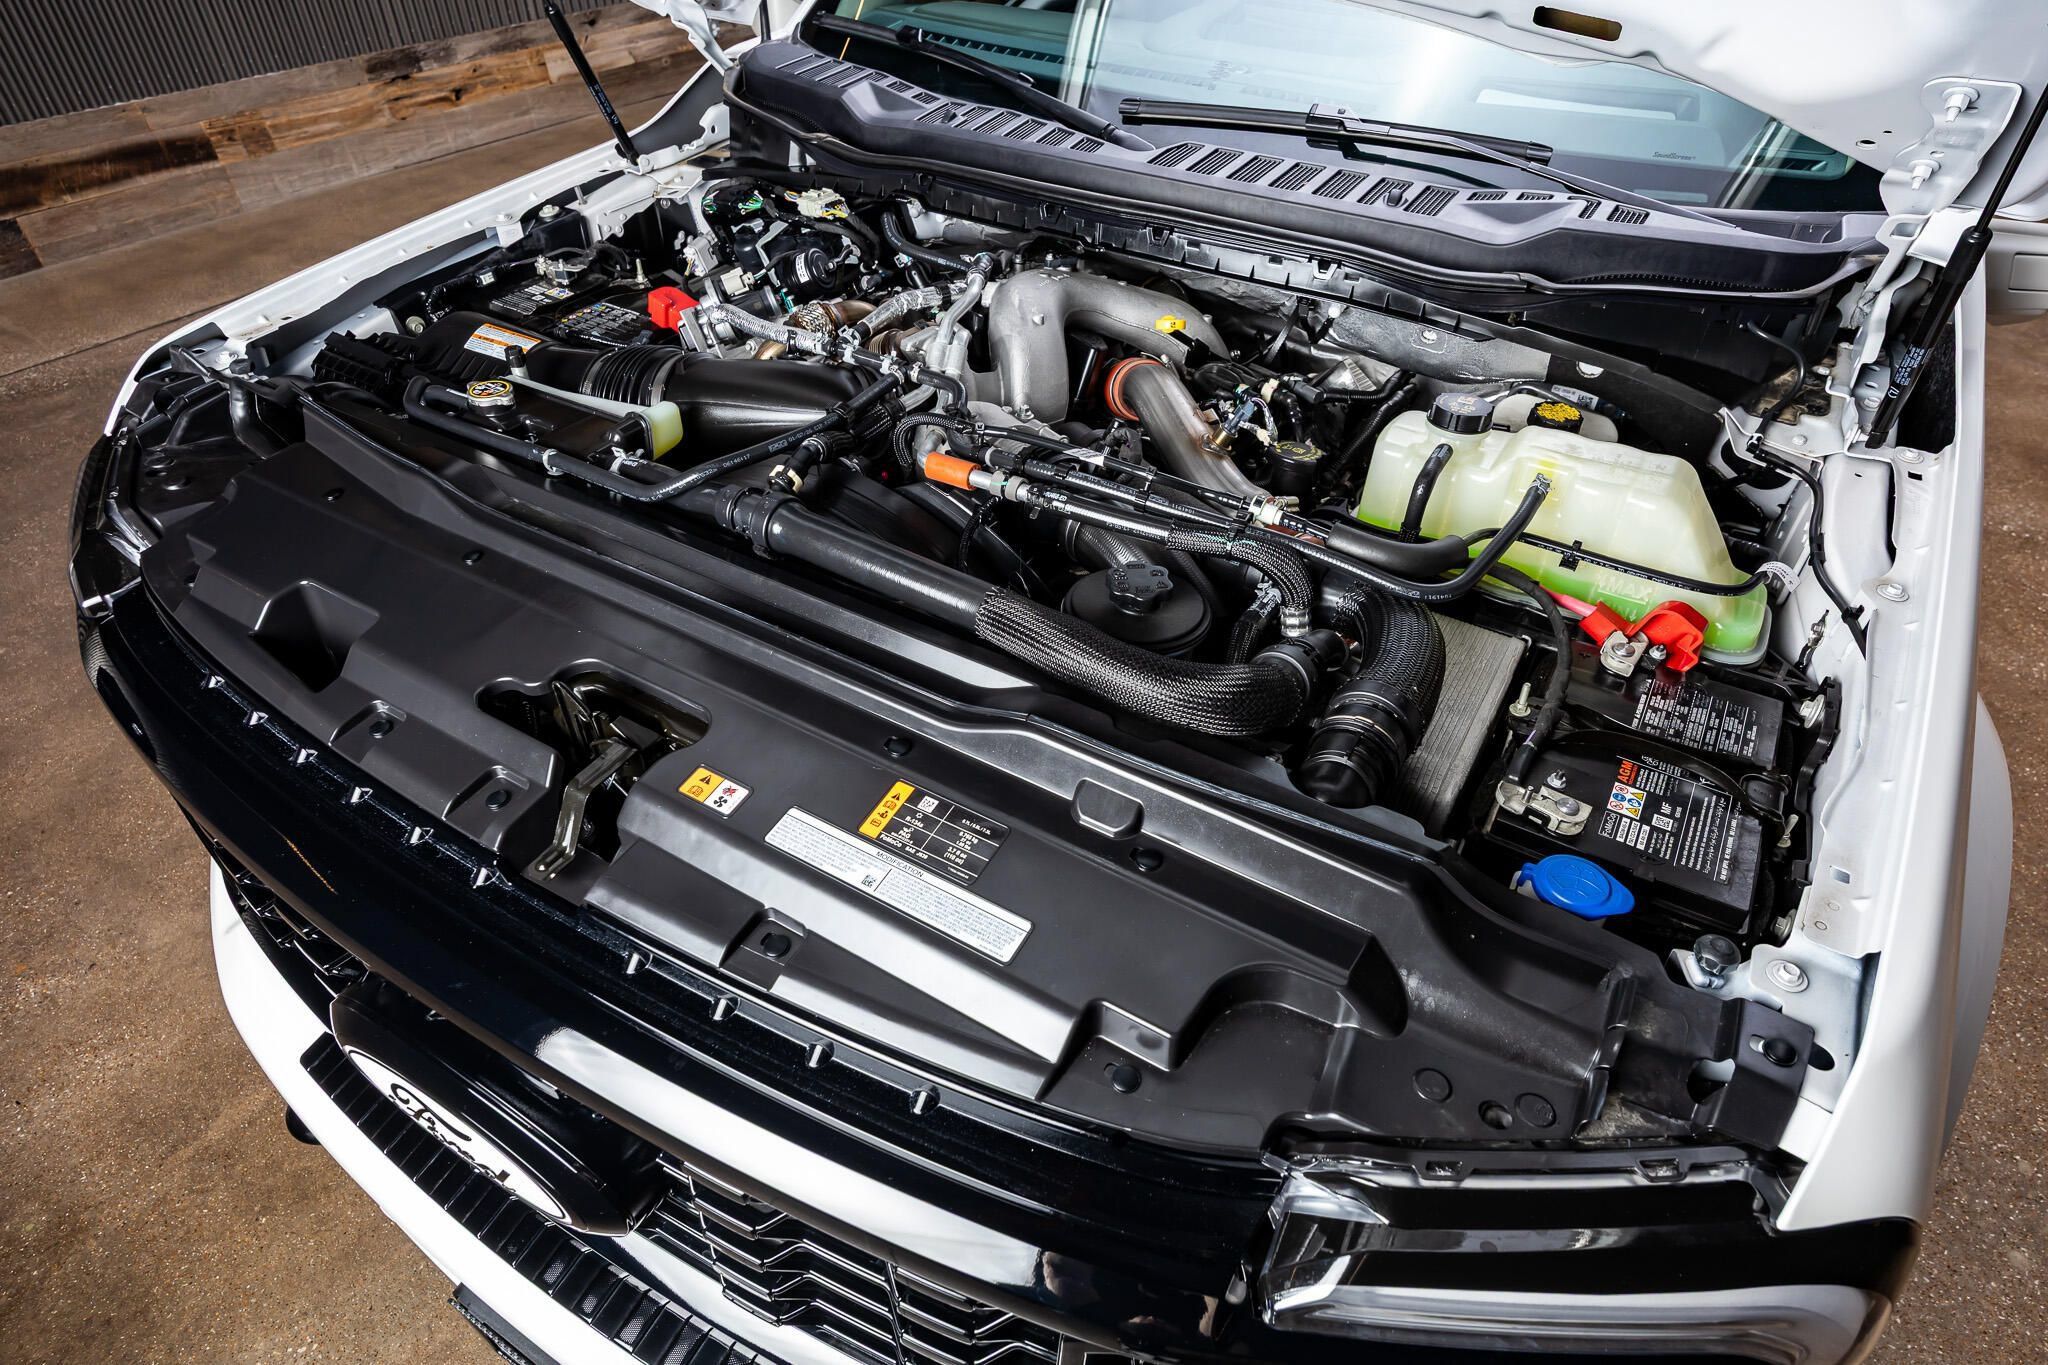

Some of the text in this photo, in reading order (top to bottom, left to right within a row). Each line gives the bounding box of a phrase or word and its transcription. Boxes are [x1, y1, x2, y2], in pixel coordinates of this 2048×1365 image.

[1618, 760, 1633, 783] AGM
[878, 833, 903, 848] FoMoCo
[876, 850, 924, 878] MODIFICATION
